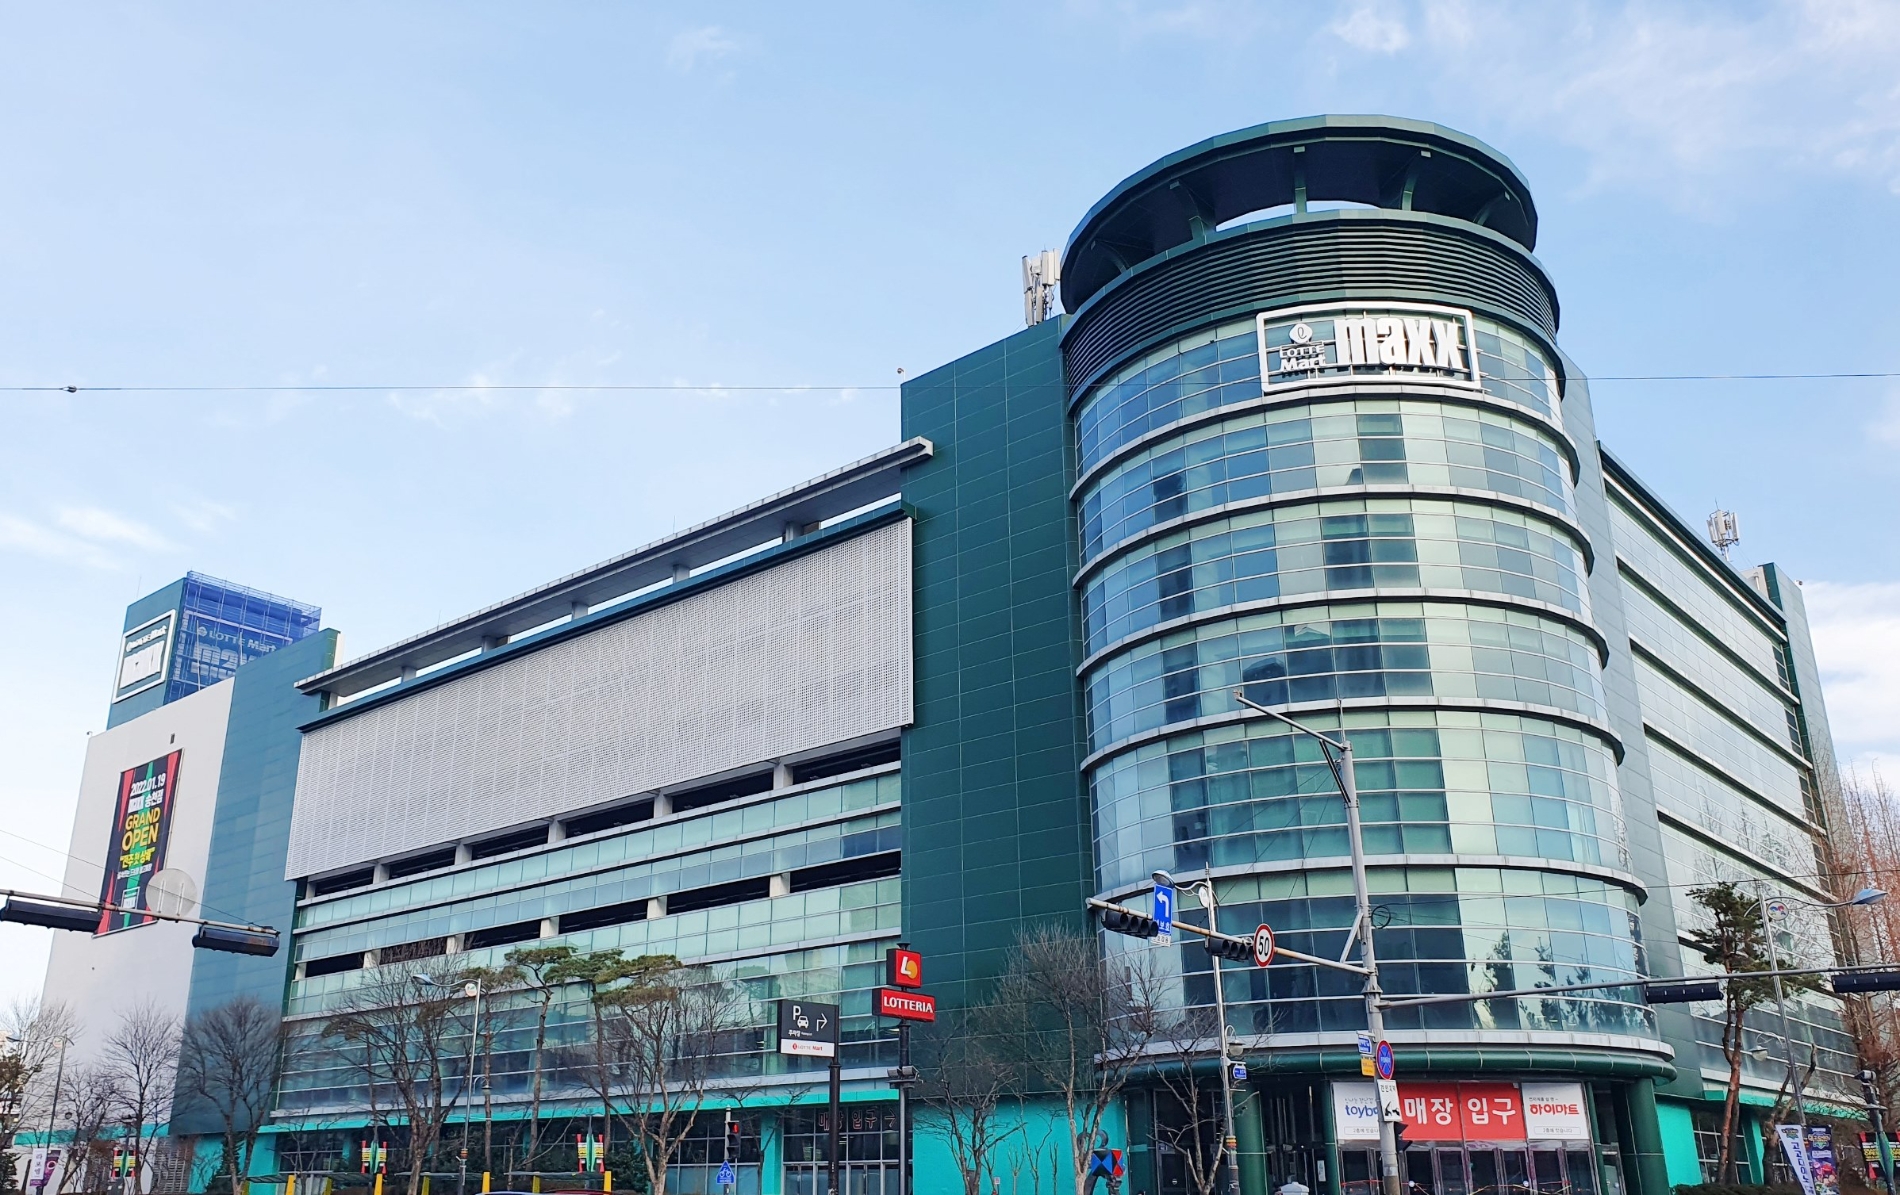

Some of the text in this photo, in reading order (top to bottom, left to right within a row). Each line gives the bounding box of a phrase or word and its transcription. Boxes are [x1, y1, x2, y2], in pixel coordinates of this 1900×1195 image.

[1279, 344, 1325, 358] LOTTE
[1333, 317, 1464, 370] maxx
[1279, 353, 1327, 372] Mart
[209, 630, 277, 652] LOTTE Mart
[125, 807, 161, 830] GRAND
[121, 822, 160, 851] OPEN
[1258, 935, 1270, 957] 50
[883, 996, 934, 1014] LOTTERIA
[851, 1108, 878, 1130] 입구
[1345, 1105, 1379, 1118] toybo
[1403, 1097, 1516, 1126] 매장 입구
[1529, 1103, 1580, 1116] 하이마트
